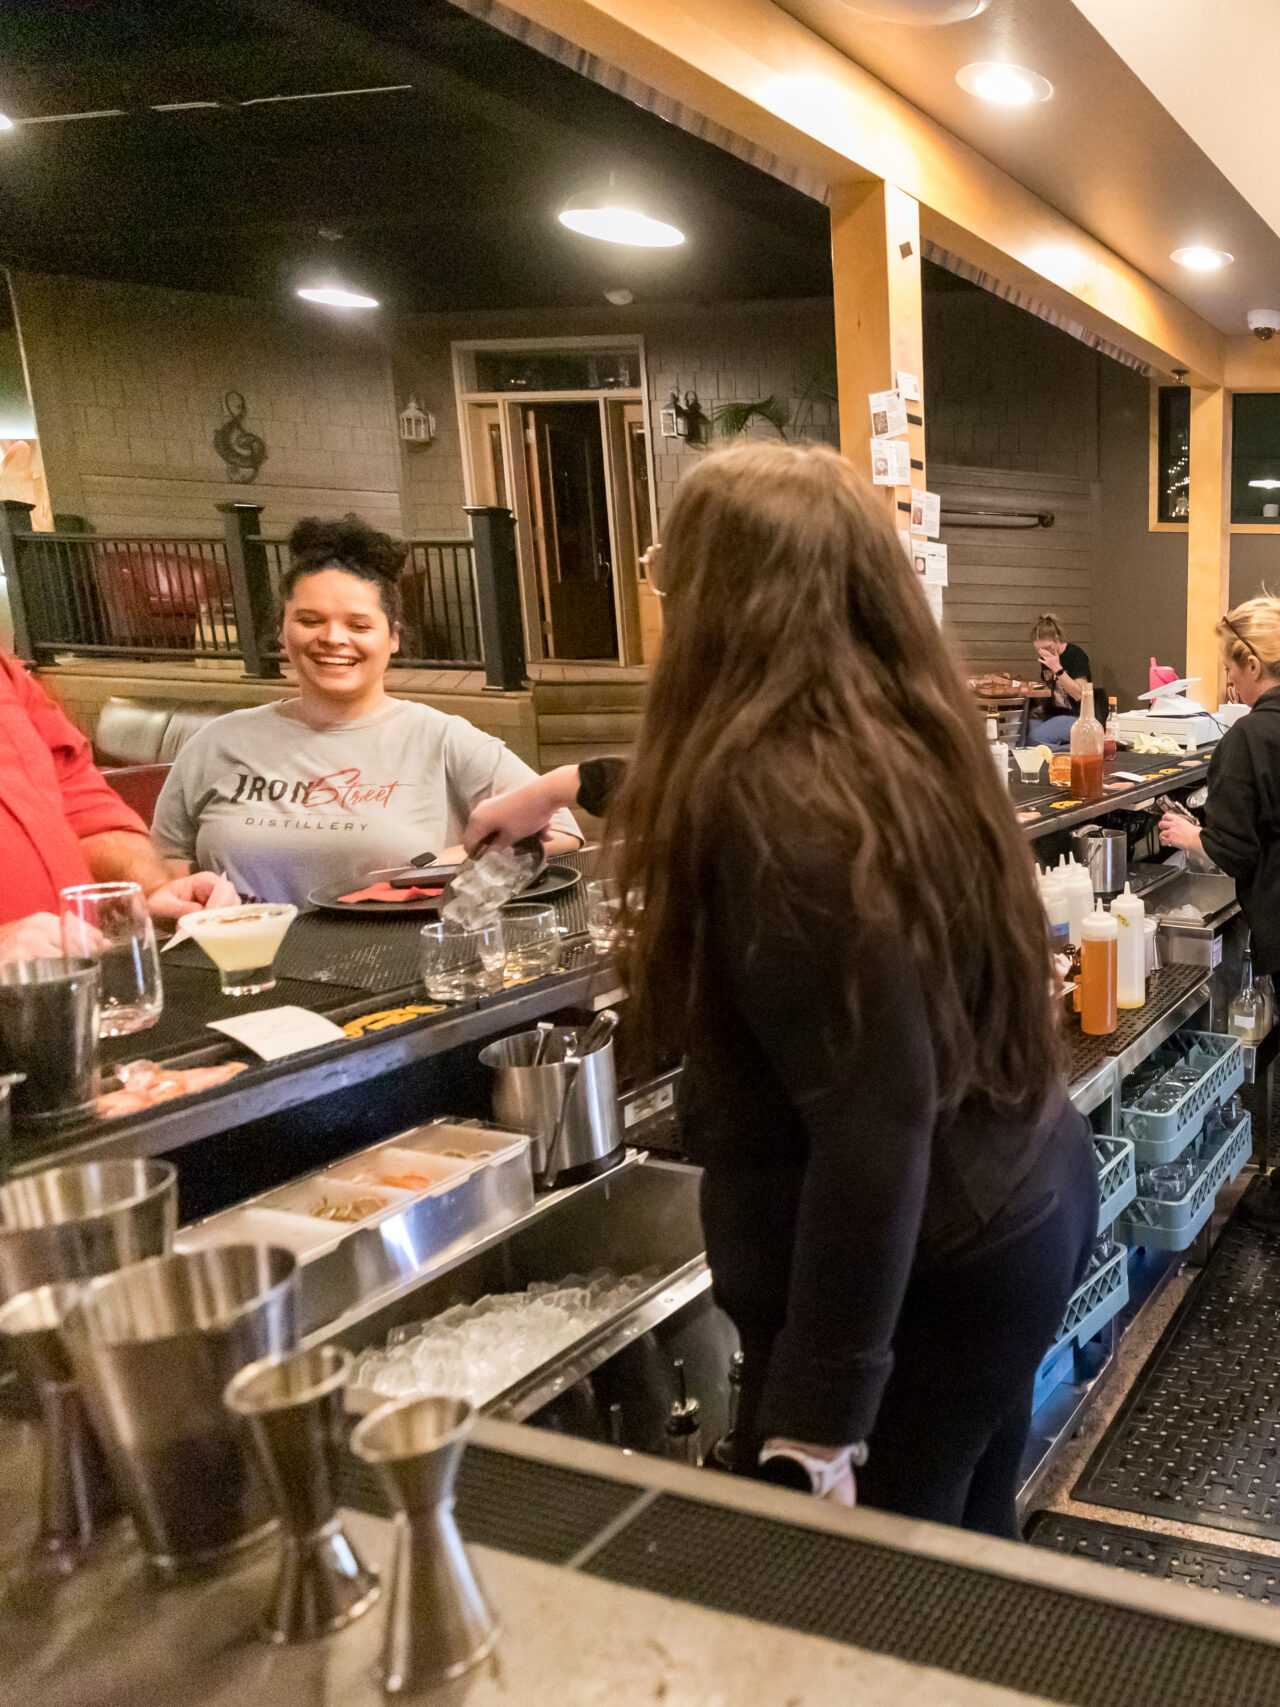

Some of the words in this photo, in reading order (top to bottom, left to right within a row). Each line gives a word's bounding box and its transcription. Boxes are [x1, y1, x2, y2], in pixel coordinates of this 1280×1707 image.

[230, 773, 315, 804] IRON
[302, 768, 416, 809] Street
[245, 817, 369, 831] DISTILLERY
